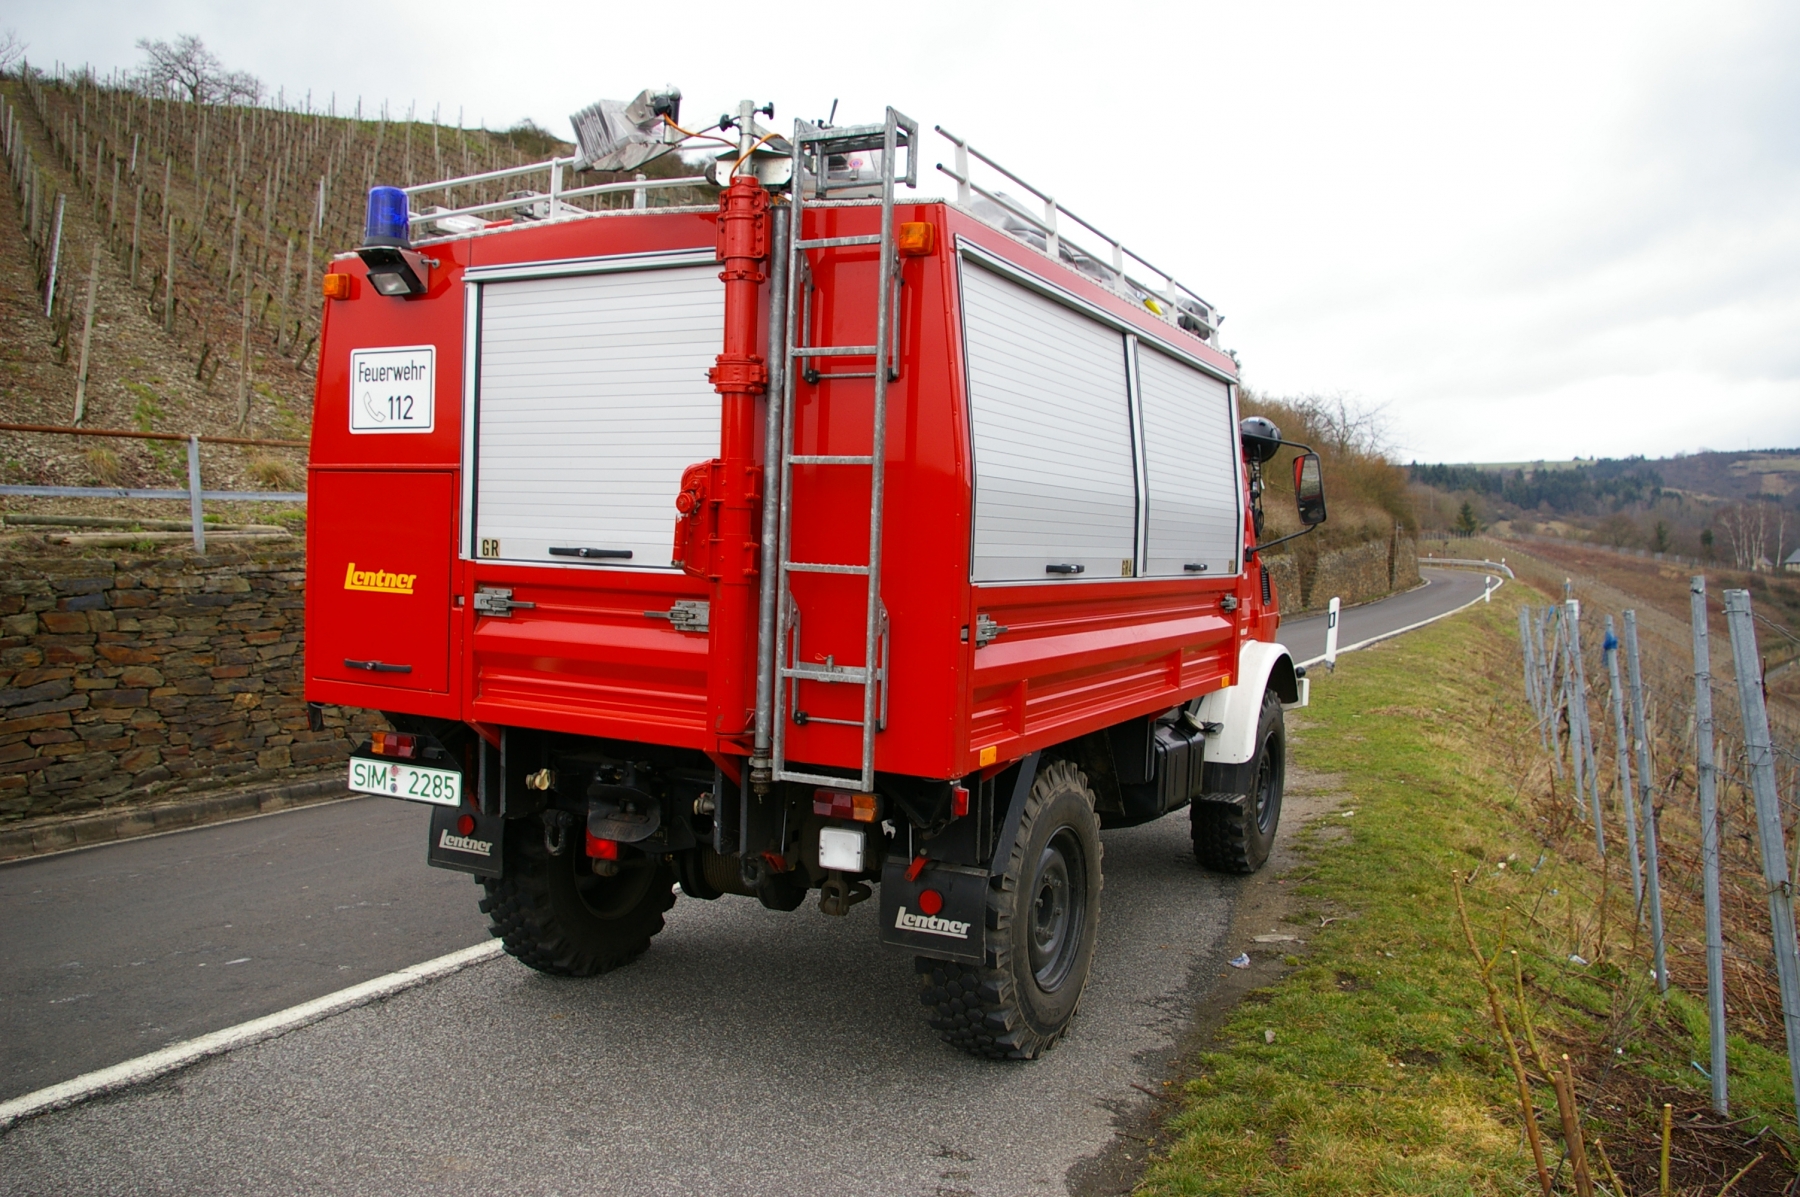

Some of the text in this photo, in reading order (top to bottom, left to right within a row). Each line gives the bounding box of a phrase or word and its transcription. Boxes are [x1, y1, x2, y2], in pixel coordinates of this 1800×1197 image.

[359, 359, 426, 383] Feuerwehr
[388, 395, 414, 420] 112
[482, 539, 499, 556] GR
[344, 562, 418, 595] Lentner
[408, 771, 455, 800] 2285
[439, 828, 493, 857] Lentner
[895, 906, 971, 939] Lentner
